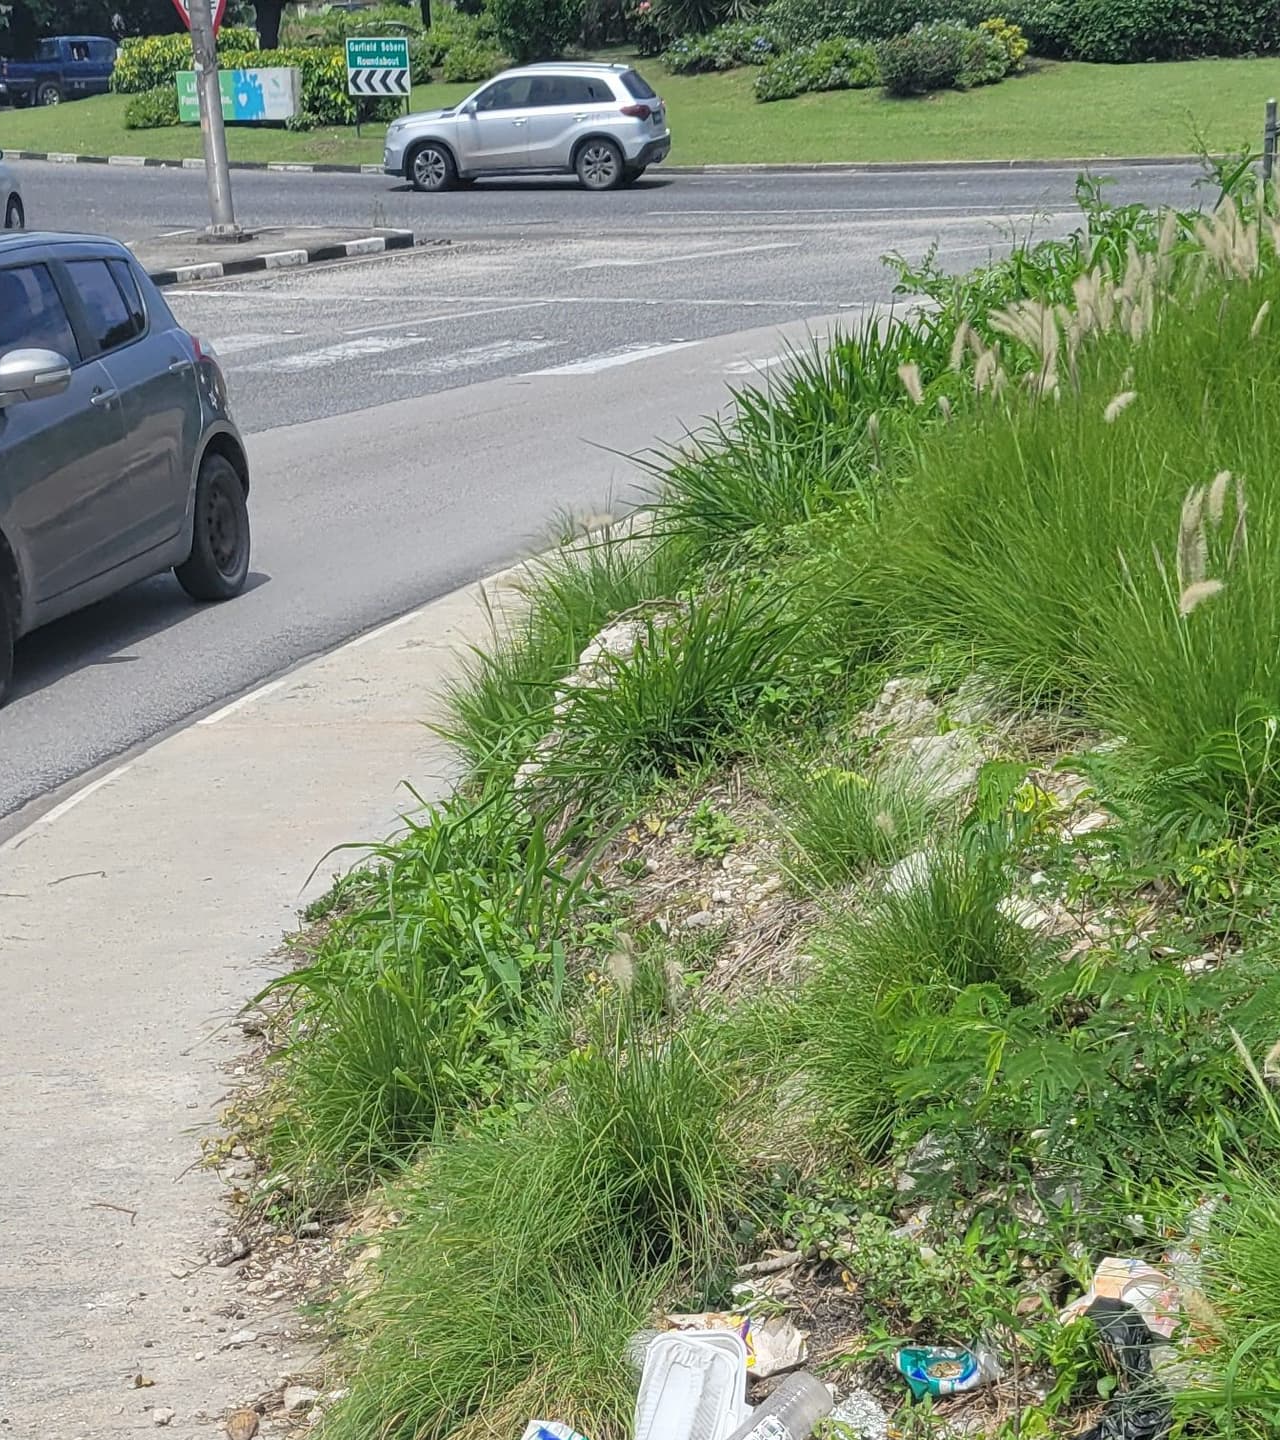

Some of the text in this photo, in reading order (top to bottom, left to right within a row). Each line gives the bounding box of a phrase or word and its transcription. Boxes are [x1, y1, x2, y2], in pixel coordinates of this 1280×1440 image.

[349, 42, 405, 52] Garfield Sobers
[356, 56, 400, 66] Roundabout
